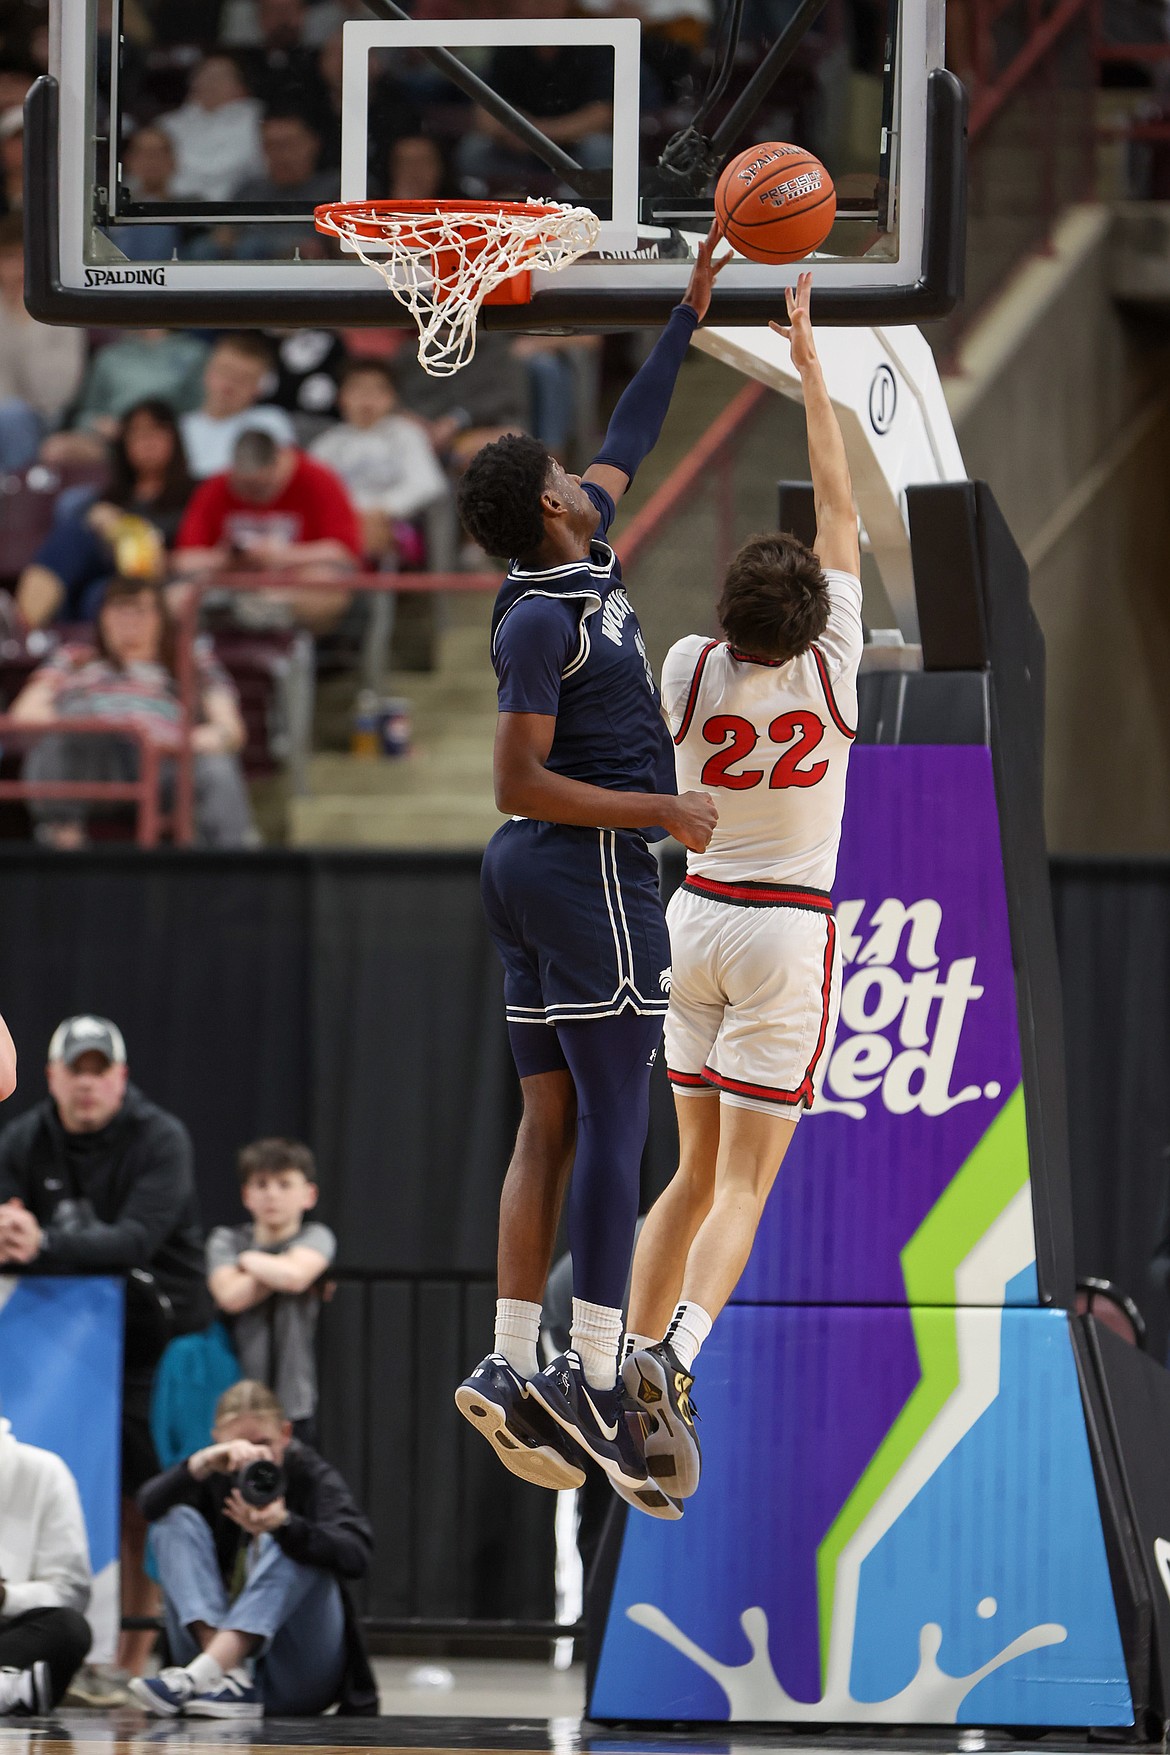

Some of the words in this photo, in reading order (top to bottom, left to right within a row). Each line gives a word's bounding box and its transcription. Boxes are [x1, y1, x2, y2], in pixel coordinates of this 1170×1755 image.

[738, 147, 812, 187] SPALDIN
[759, 170, 823, 204] PRECISION
[84, 267, 165, 287] SPALDING
[700, 709, 830, 790] 22
